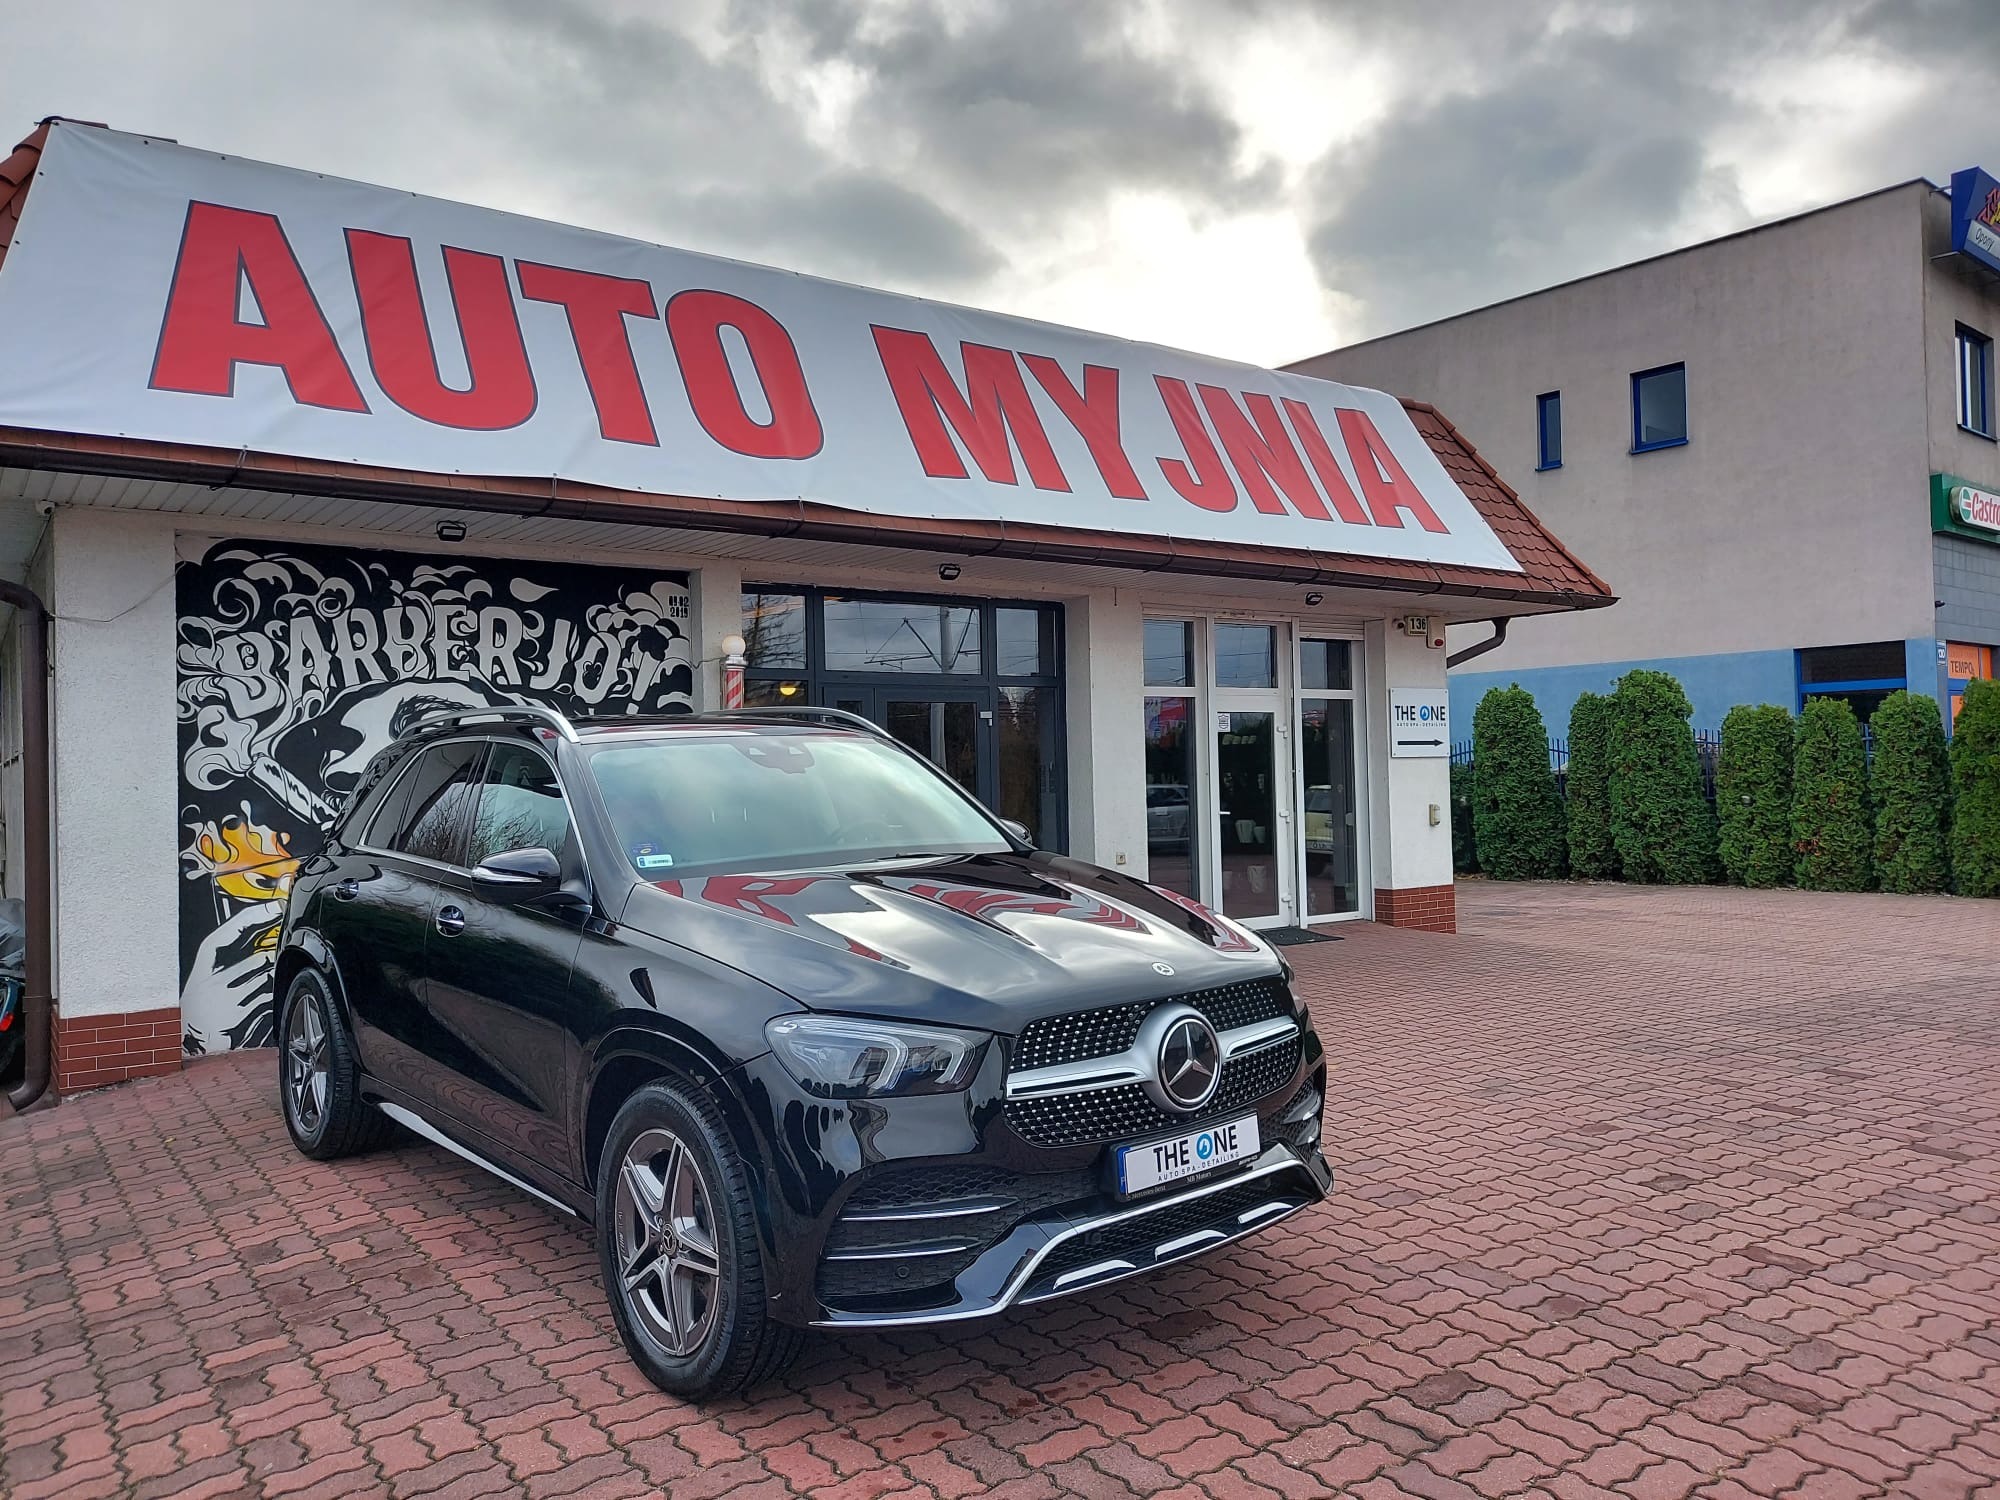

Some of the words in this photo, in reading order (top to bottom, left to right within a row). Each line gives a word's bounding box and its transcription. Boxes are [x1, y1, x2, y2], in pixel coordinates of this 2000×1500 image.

[1975, 228, 1995, 251] Opony
[148, 199, 824, 461] AUTO
[869, 323, 1451, 535] MYJNIA
[1409, 618, 1426, 630] 136
[1395, 705, 1416, 721] THE
[1420, 705, 1446, 721] ONE
[1153, 1139, 1190, 1173] THE
[1196, 1125, 1238, 1160] ONE
